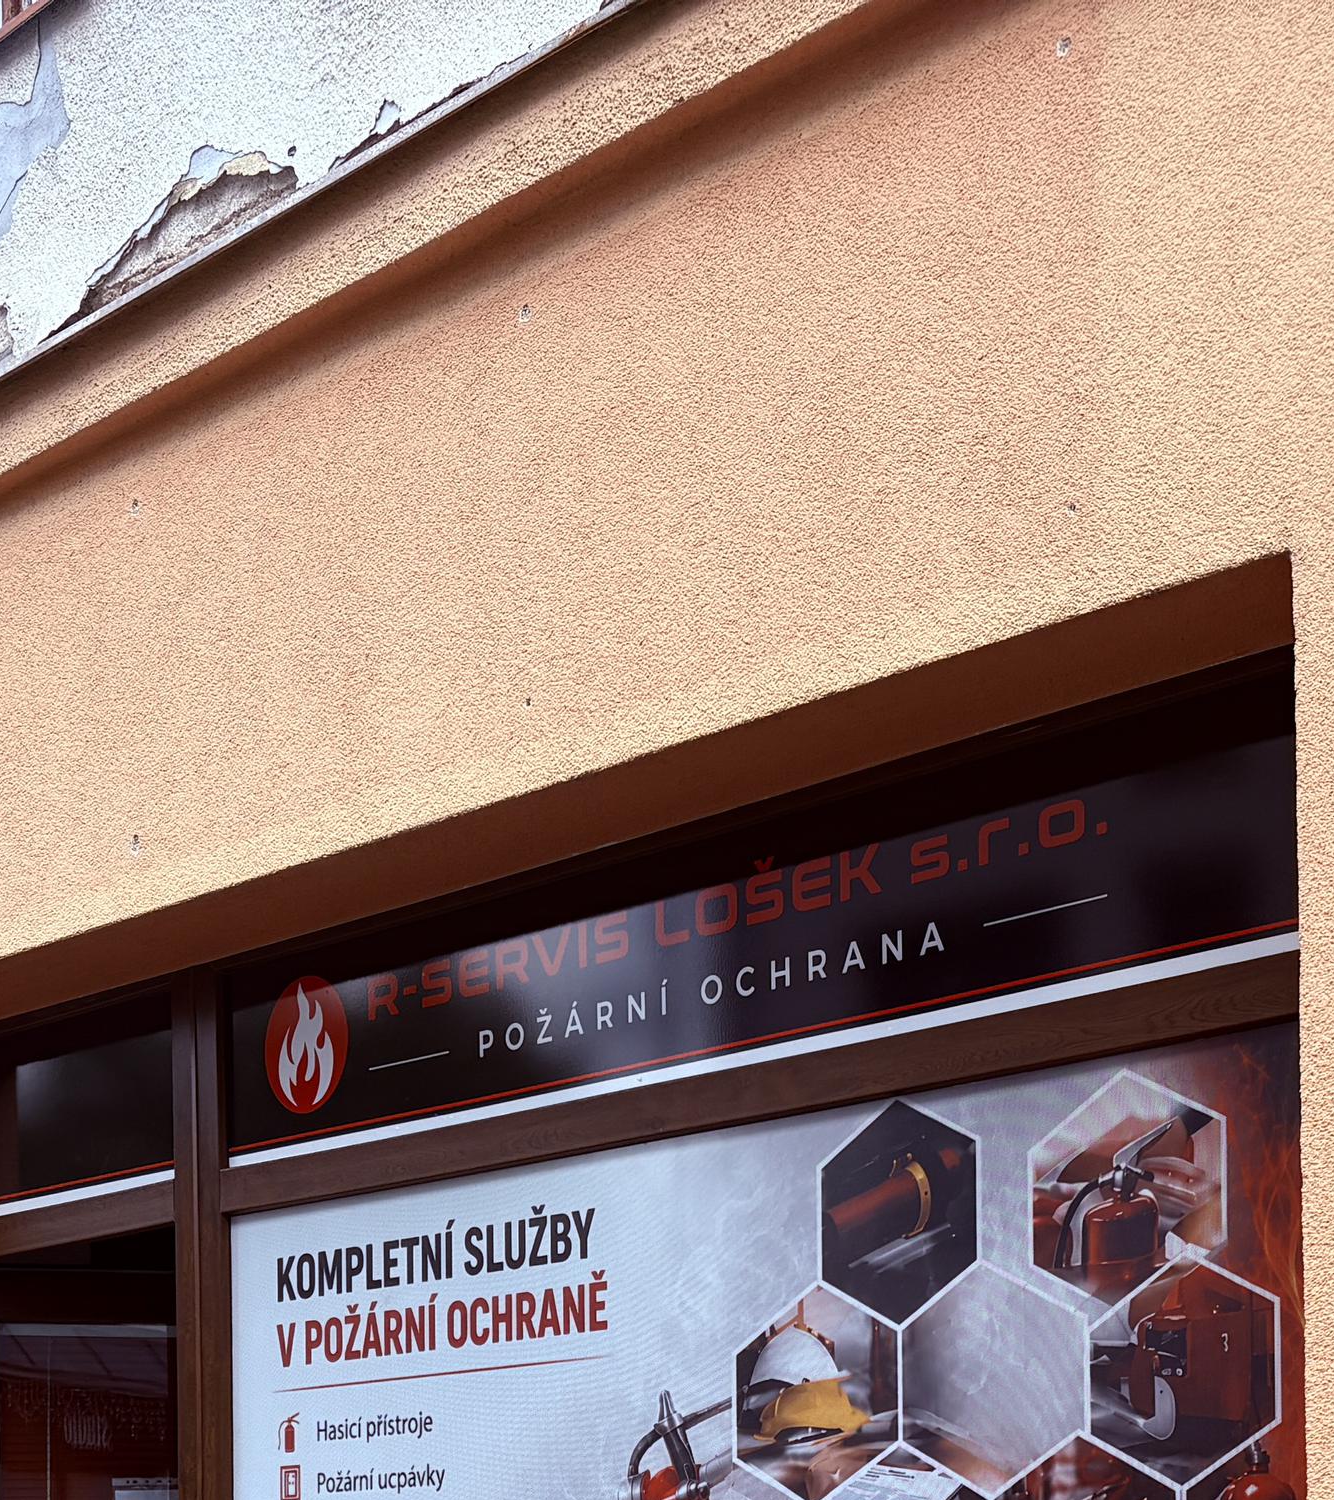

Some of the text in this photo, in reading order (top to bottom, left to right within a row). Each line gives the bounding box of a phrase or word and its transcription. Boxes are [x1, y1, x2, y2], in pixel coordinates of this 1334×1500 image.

[367, 799, 1109, 1022] R-SERVIS LOŠEK s.r.o.
[478, 921, 946, 1059] POŽÁRNÍ OCHRANA
[276, 1203, 596, 1303] KOMPLETNÍ SLUŽBY
[276, 1269, 608, 1368] V POŽÁRNÍ OCHRANĚ
[316, 1410, 434, 1444] Hasicí přístroje
[316, 1463, 446, 1494] Požární ucpávky
